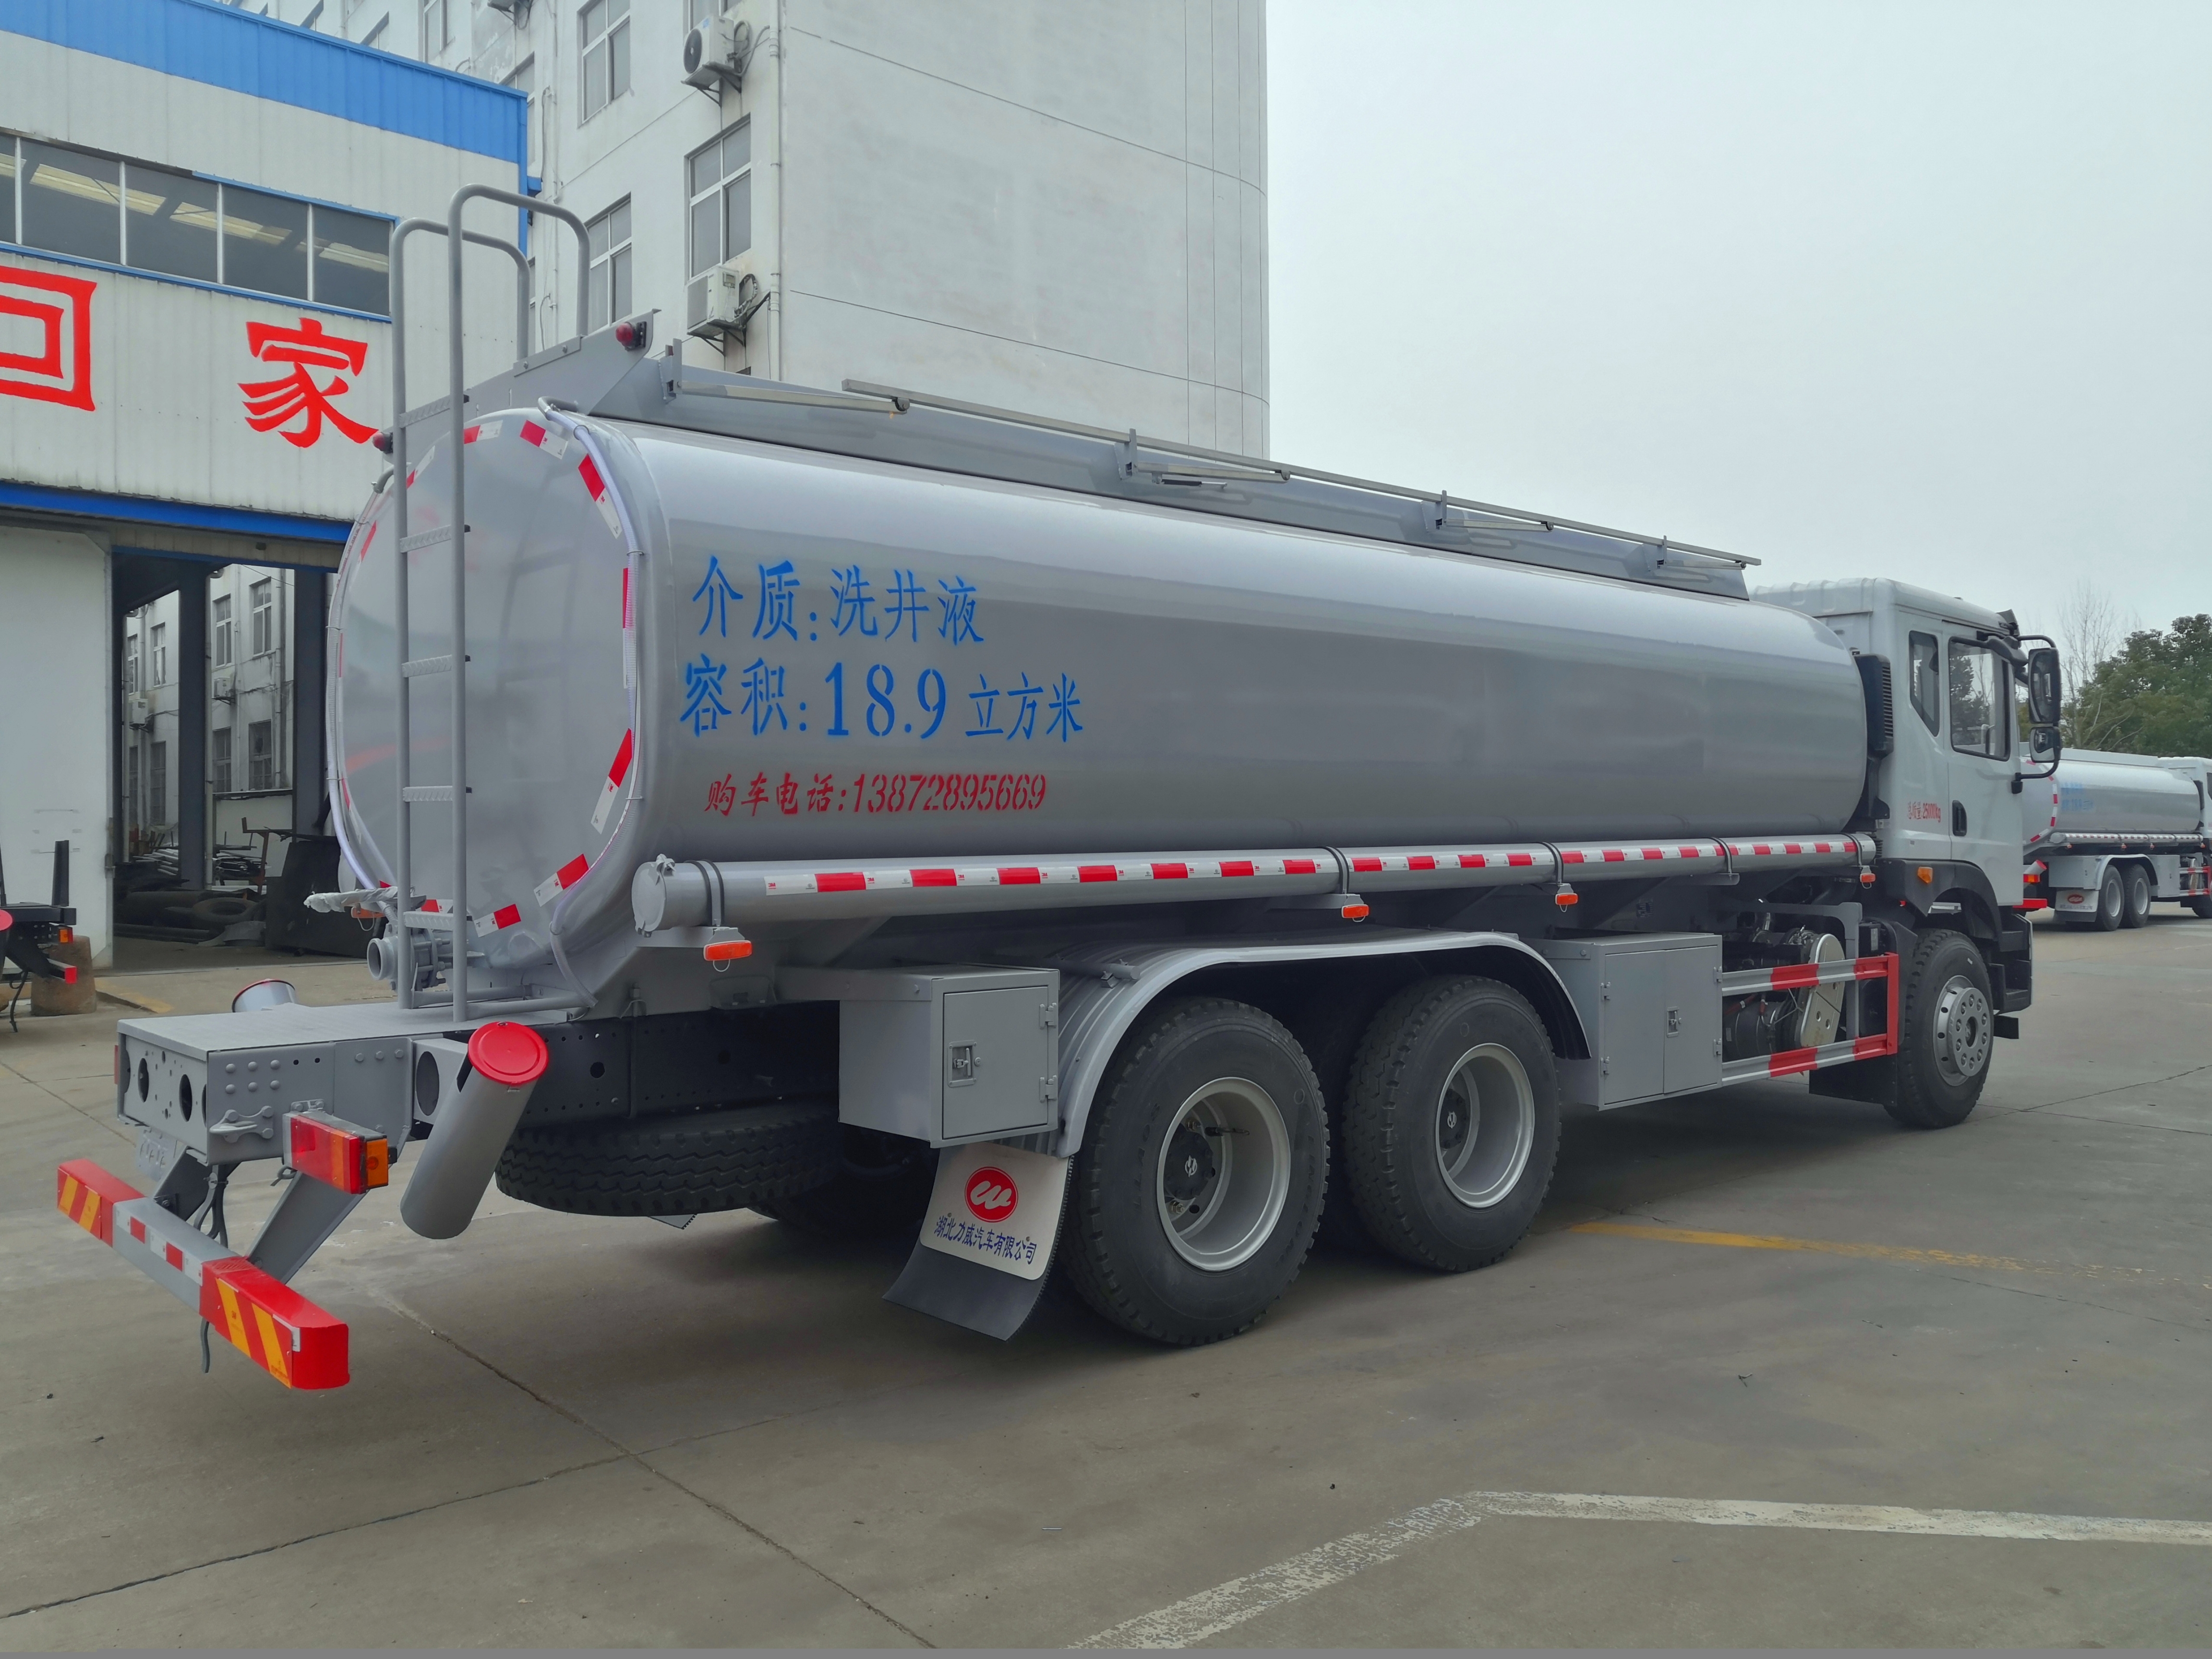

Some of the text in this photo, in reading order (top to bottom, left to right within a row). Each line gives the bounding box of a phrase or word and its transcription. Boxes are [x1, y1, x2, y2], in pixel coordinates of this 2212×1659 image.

[692, 555, 984, 646] 介质:洗井液
[704, 772, 1046, 817] 购车电话:13872895669
[934, 1215, 1037, 1265] 湖北力威汽车有限公司
